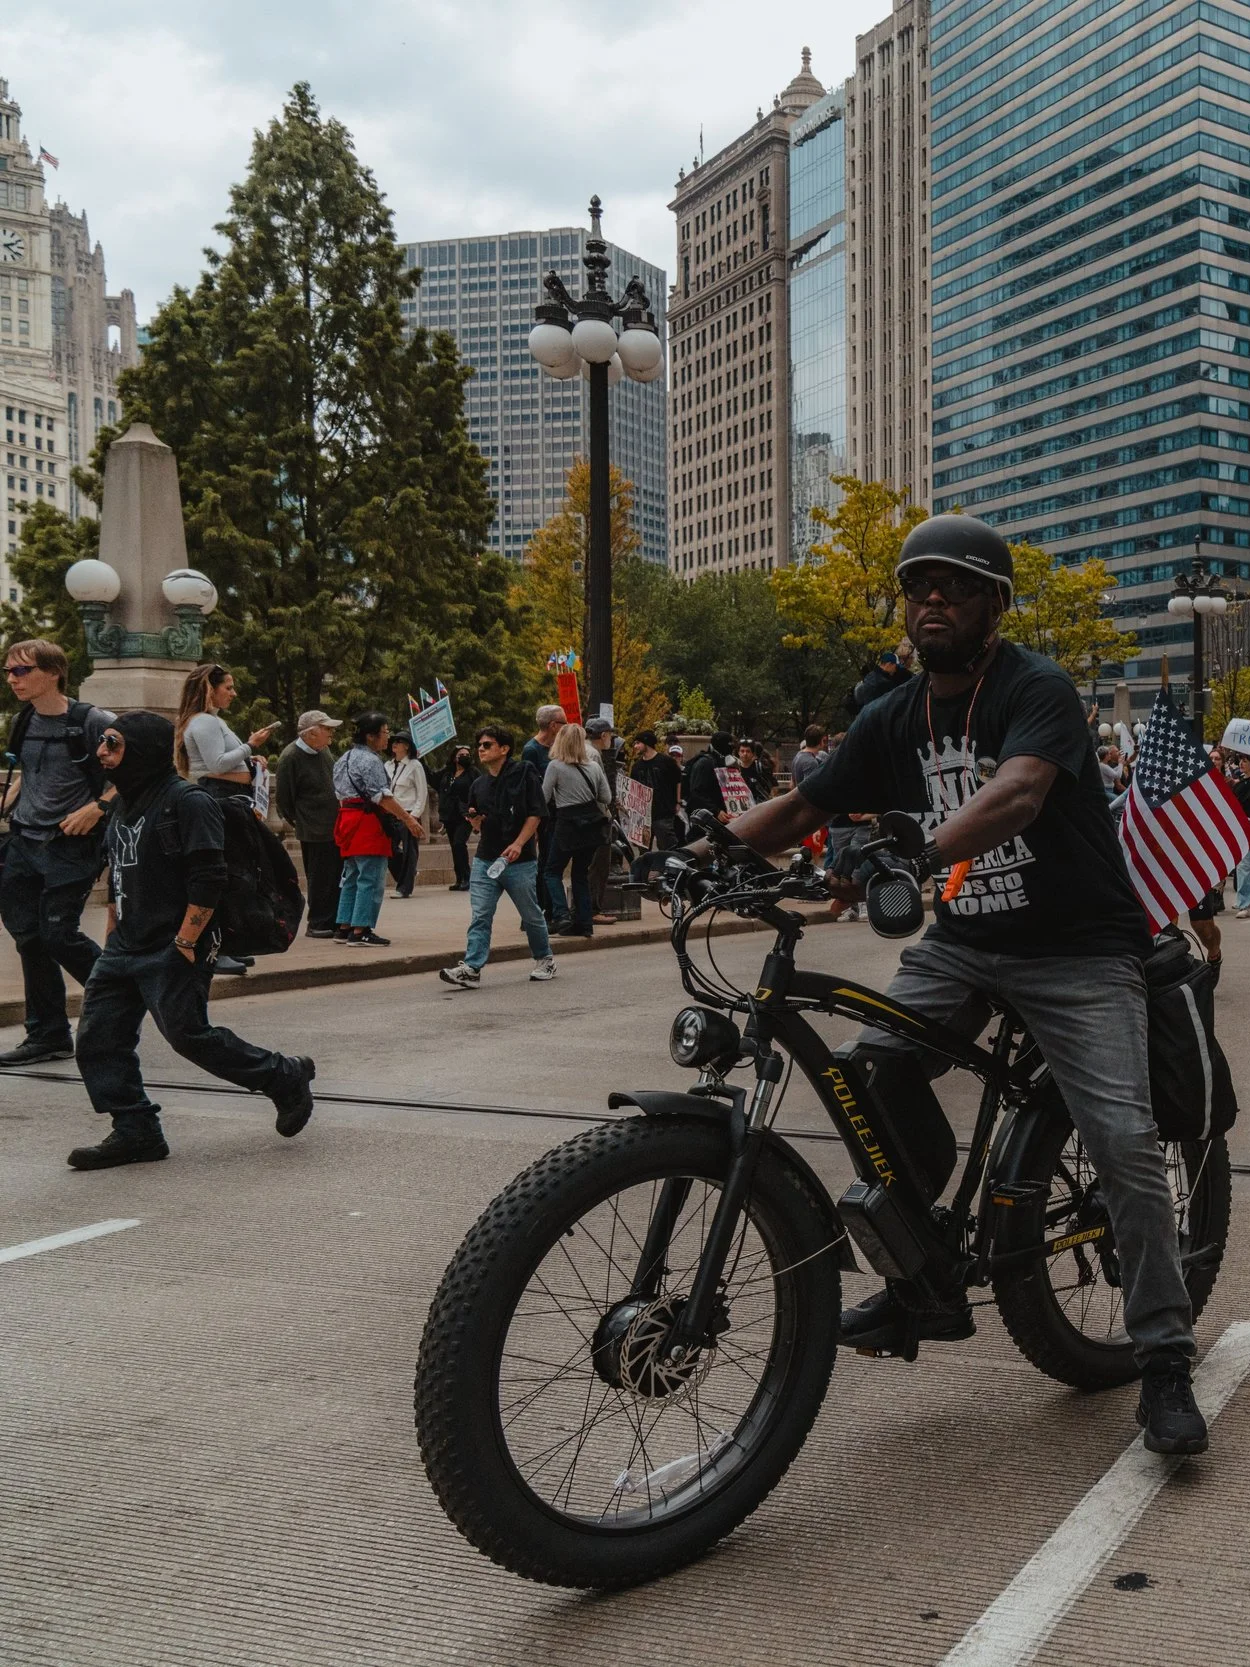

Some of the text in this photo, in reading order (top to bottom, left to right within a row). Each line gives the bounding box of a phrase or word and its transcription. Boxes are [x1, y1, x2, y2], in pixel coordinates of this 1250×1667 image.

[928, 769, 979, 813] NO
[941, 835, 1034, 874] ERICA
[988, 872, 1024, 893] GO
[820, 1067, 898, 1187] POLEEJIEK
